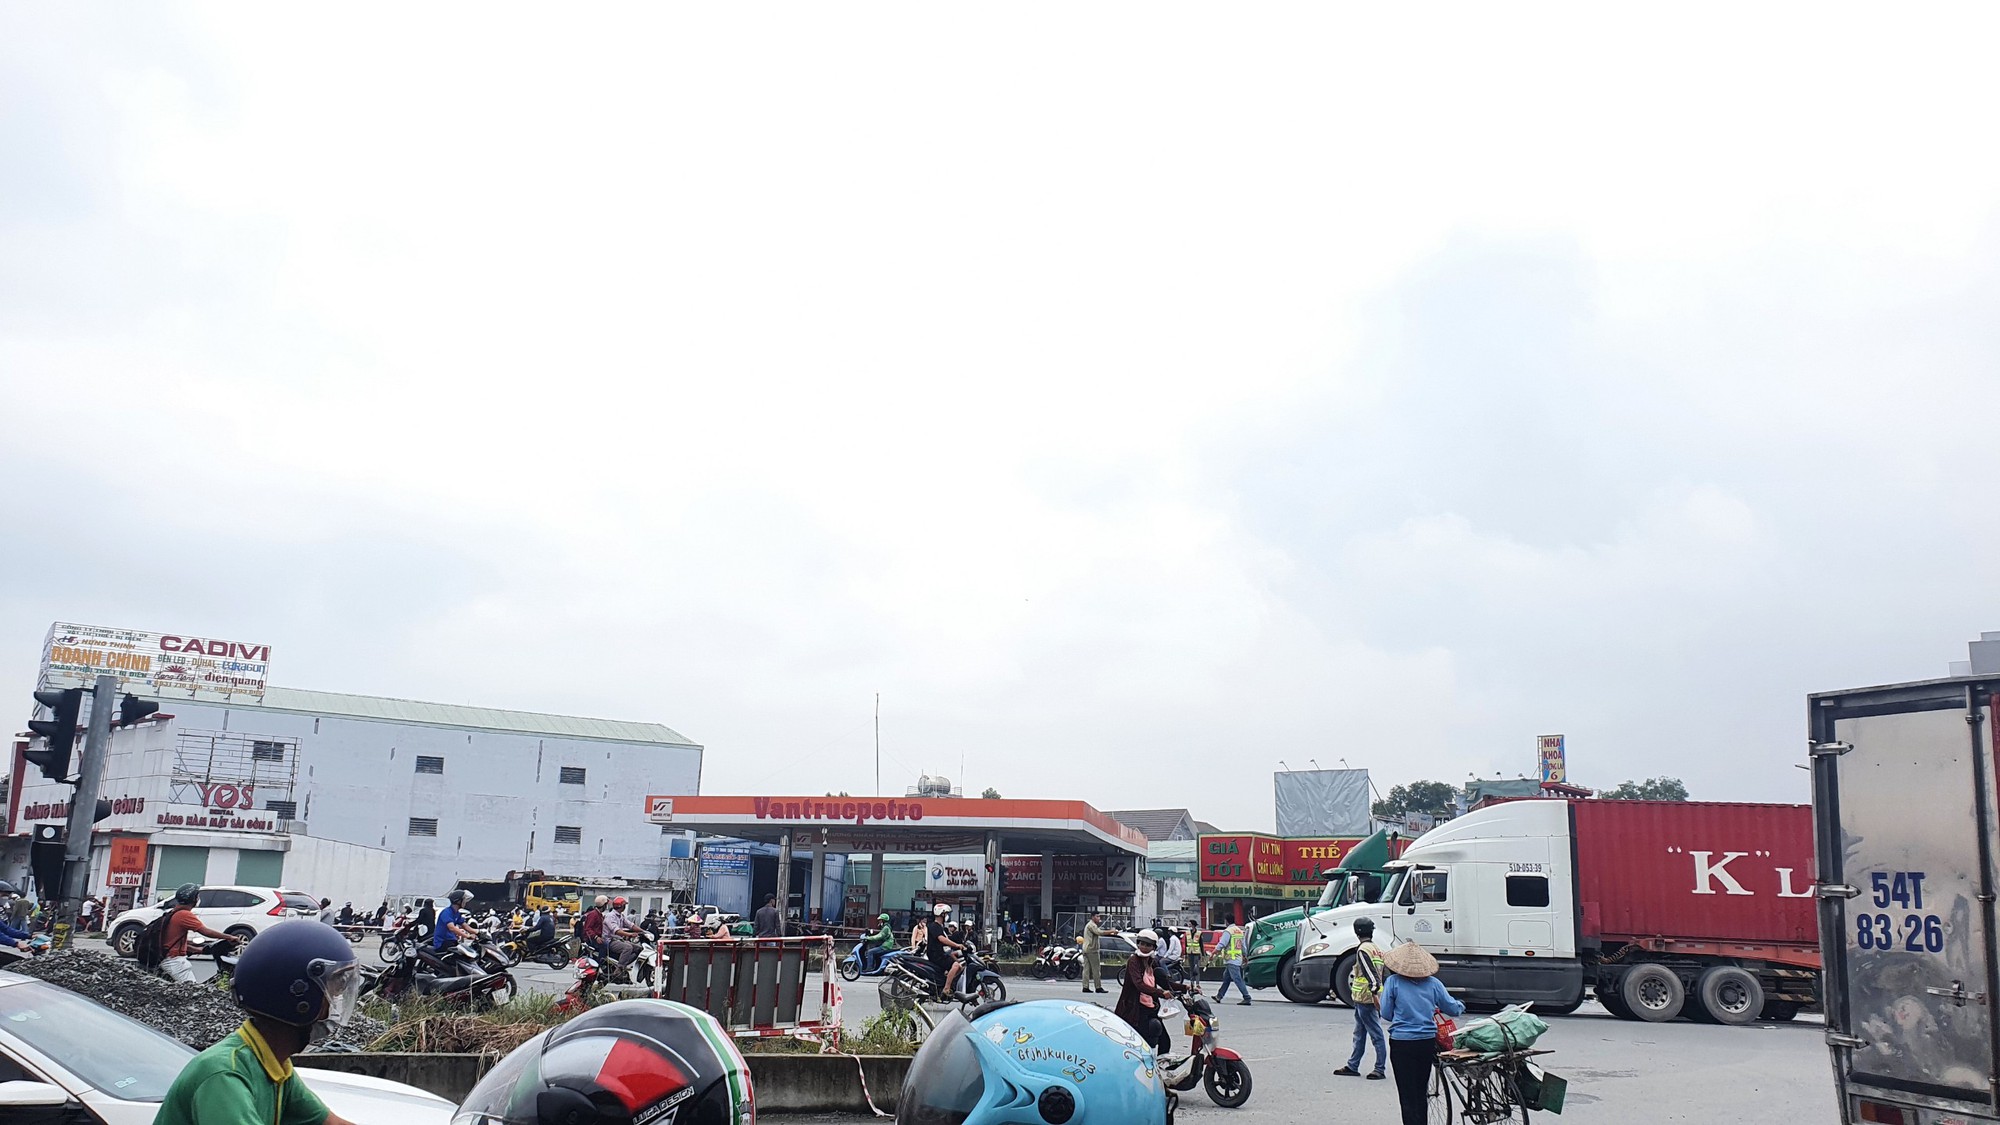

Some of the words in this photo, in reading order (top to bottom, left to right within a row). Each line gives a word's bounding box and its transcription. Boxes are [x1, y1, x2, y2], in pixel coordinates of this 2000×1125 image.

[51, 645, 102, 666] DOANH
[160, 635, 268, 661] CADIVI
[230, 677, 264, 689] quang
[1544, 738, 1561, 748] NHA
[1543, 750, 1563, 760] KHOA
[1550, 771, 1558, 780] 6
[136, 798, 145, 814] 5
[754, 797, 923, 825] Vantrucpetro
[267, 820, 273, 830] 5
[1208, 839, 1239, 854] GIÁ
[1261, 842, 1270, 854] UY
[1270, 841, 1281, 856] TÍN
[1298, 841, 1341, 859] THẾ
[945, 866, 976, 878] TOTAL
[1206, 859, 1243, 876] TỐT
[1291, 863, 1327, 881] MẮ
[1012, 871, 1035, 881] XĂNG
[1058, 871, 1076, 881] VÂN
[1079, 871, 1104, 881] TRÚC
[1872, 872, 1926, 909] 54T
[659, 1085, 695, 1112] DESIGN
